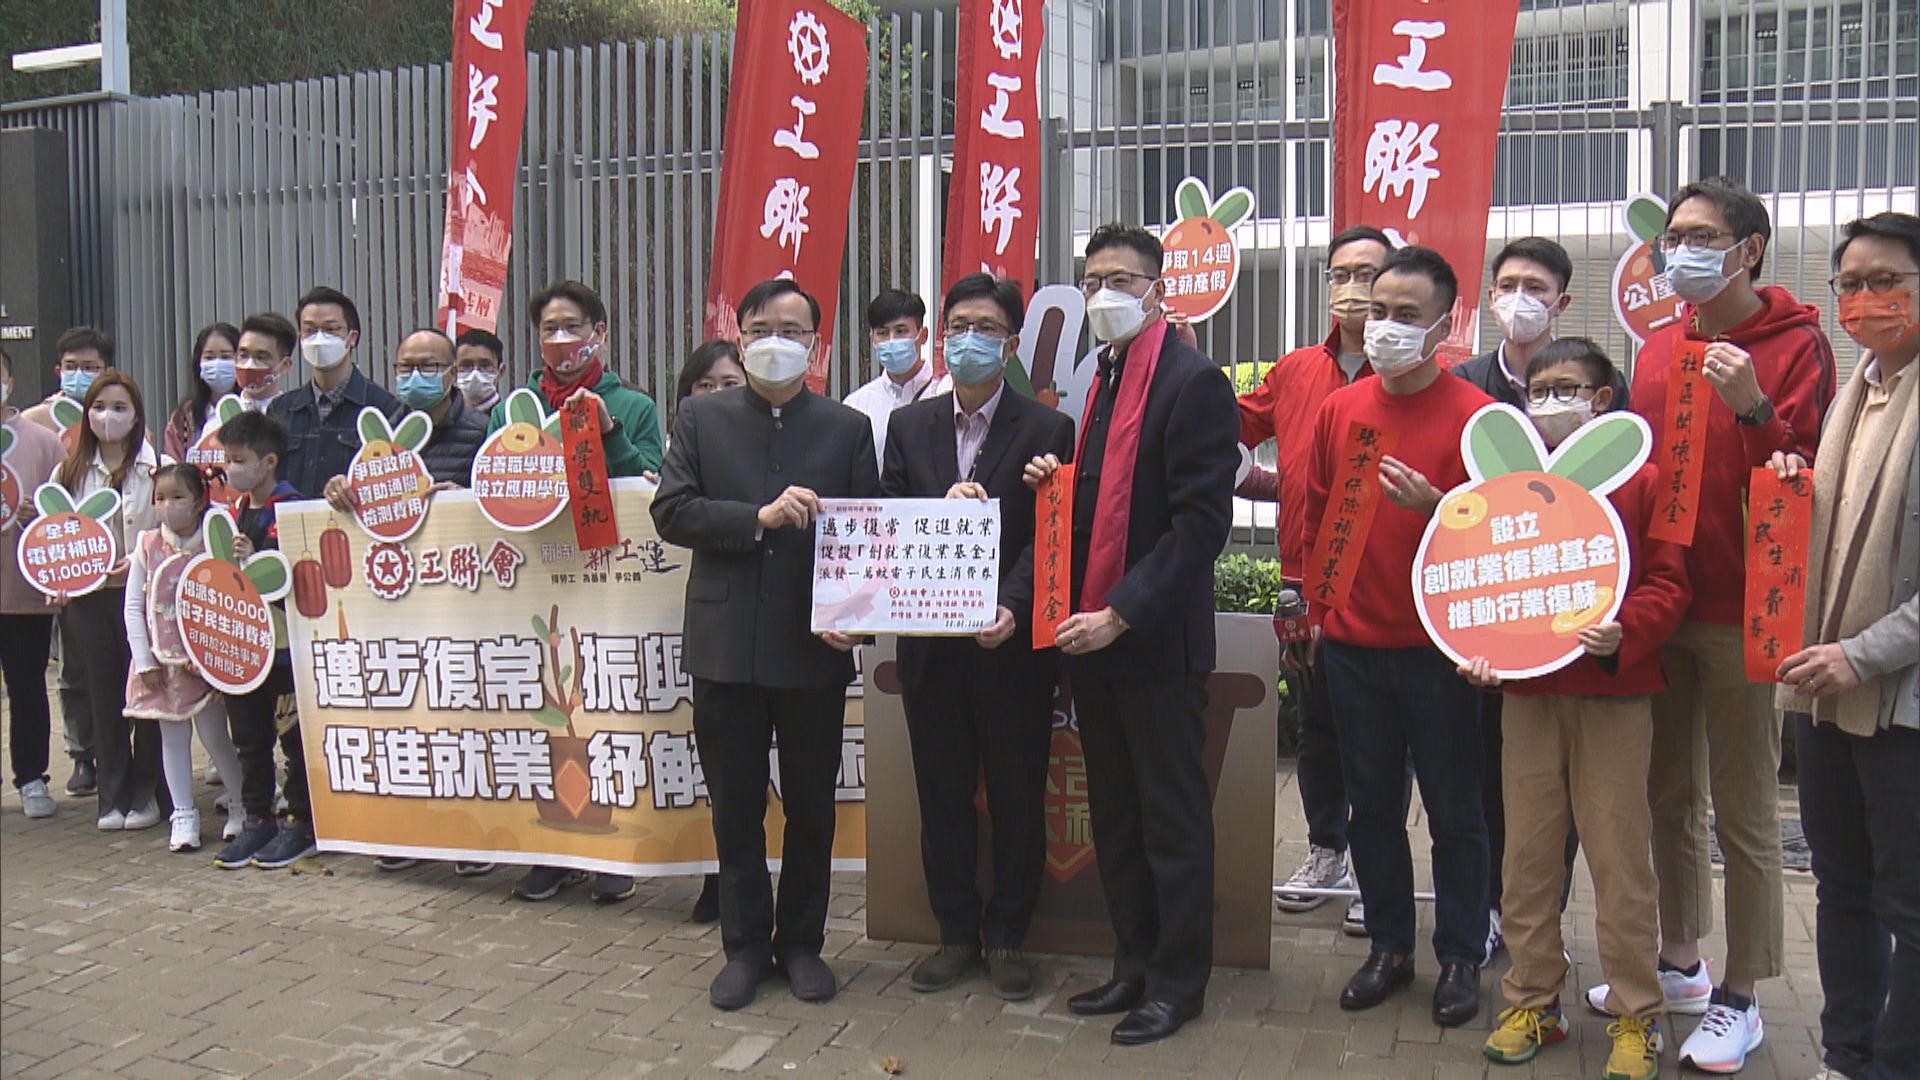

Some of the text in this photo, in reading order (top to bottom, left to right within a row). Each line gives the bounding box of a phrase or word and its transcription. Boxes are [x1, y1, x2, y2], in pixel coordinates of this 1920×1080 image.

[1363, 20, 1453, 248] 工聯
[760, 95, 820, 280] 工聯
[980, 72, 1024, 275] 工聯
[354, 450, 414, 481] 爭取政府
[474, 480, 568, 498] 設立應用學位
[27, 536, 108, 566] 電費補貼
[45, 520, 81, 540] 全年
[822, 517, 995, 537] 邁步復常 促進就業
[1490, 511, 1540, 545] 設立
[37, 557, 106, 585] $1,000元
[417, 537, 525, 592] 工聯會
[1423, 534, 1617, 596] 創就業復業基金
[1447, 579, 1599, 630] 推動行業復蘇
[311, 634, 544, 712] 邁步復常
[323, 725, 556, 801] 促進就業
